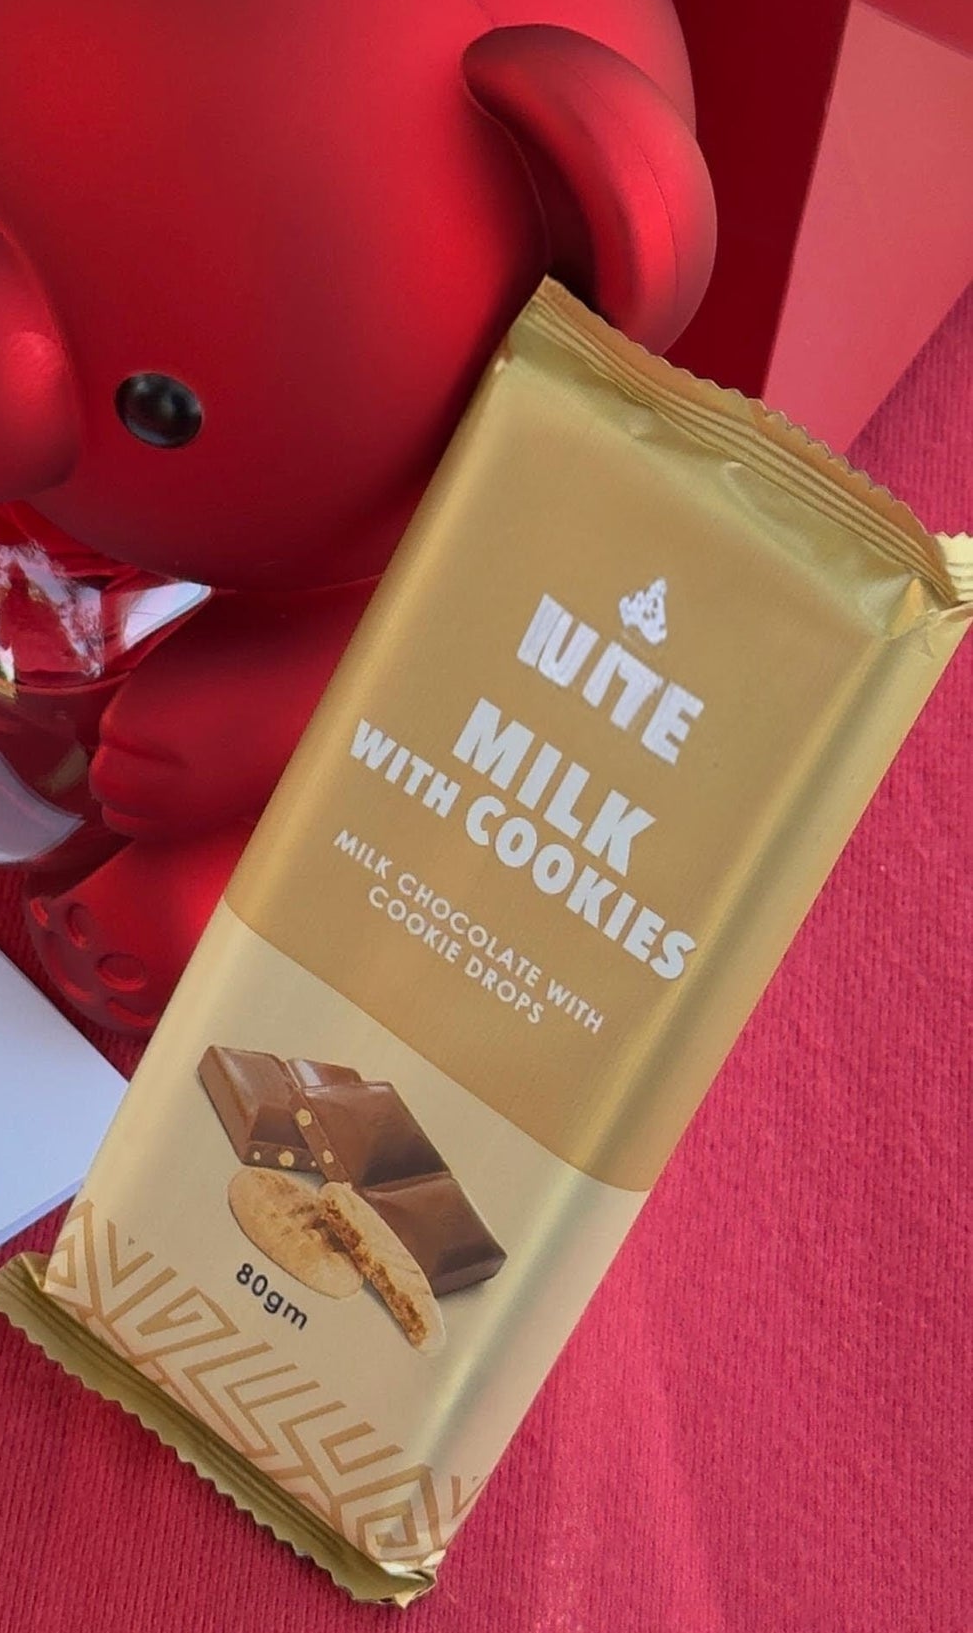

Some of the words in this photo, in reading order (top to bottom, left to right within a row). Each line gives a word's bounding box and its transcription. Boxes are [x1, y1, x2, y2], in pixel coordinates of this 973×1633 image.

[348, 717, 462, 819] WITH
[465, 794, 698, 981] COOKIES
[451, 696, 657, 877] MILK
[333, 829, 394, 881] MILK
[396, 872, 542, 988] CHOCOLATE
[545, 978, 605, 1035] WITH
[368, 885, 463, 964] COOKIE
[464, 959, 545, 1025] DROPS
[235, 1262, 308, 1330] 80gm
